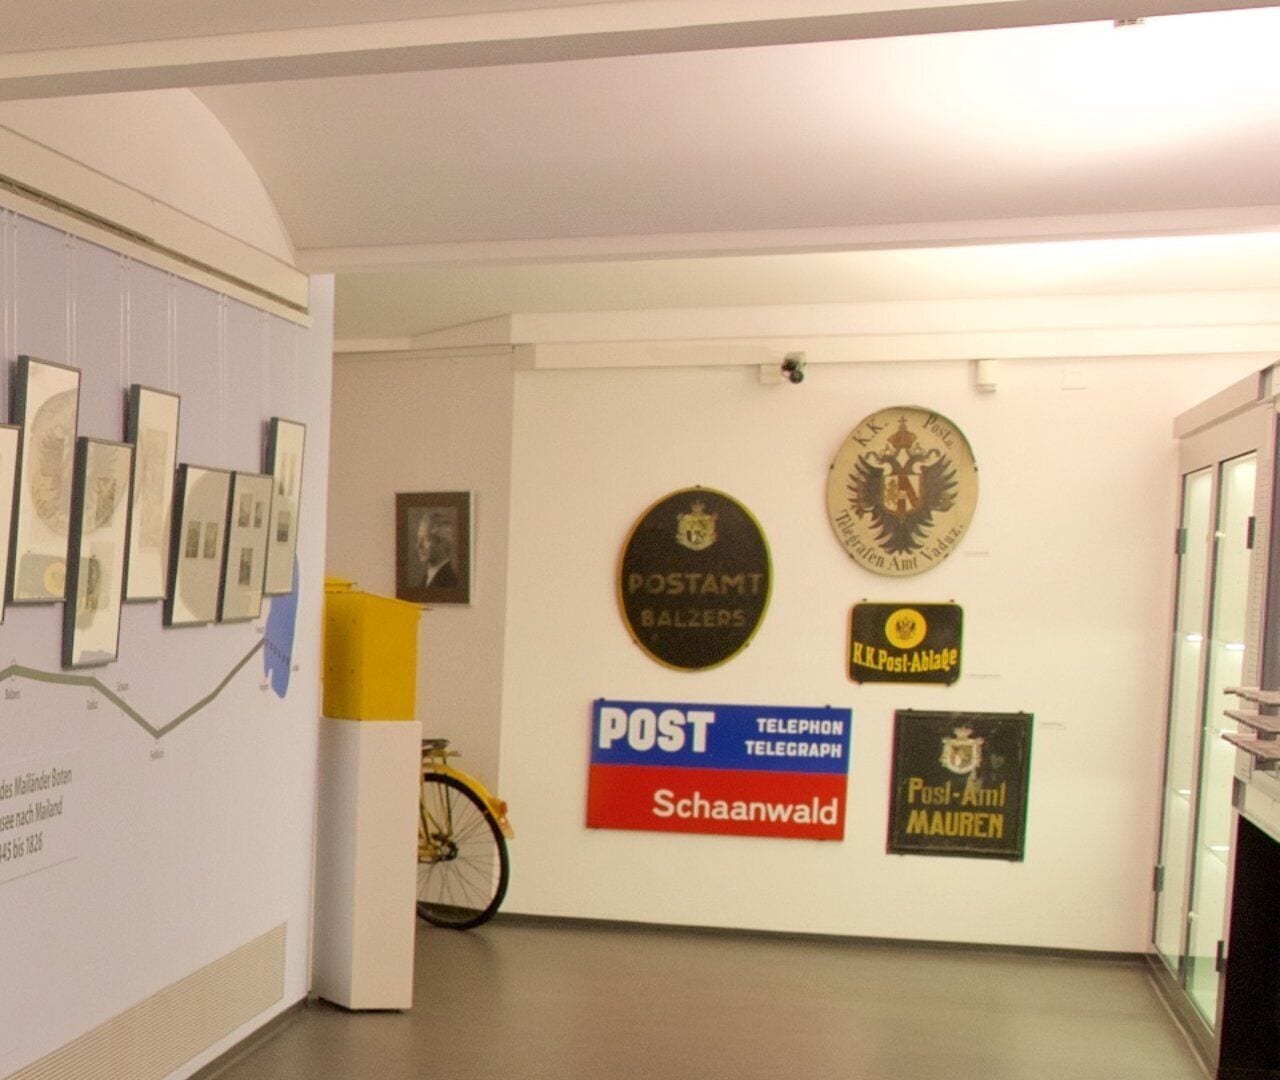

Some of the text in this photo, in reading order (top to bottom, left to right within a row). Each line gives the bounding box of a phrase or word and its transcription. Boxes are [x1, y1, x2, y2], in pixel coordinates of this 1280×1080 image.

[888, 556, 919, 572] Amt
[627, 572, 764, 596] POSTAMT
[641, 608, 747, 628] BALZERS
[598, 707, 716, 753] POST
[756, 717, 844, 736] TELEPHON
[744, 740, 843, 759] TELEGRAPH
[0, 779, 13, 800] des
[14, 770, 51, 796] Mailänder
[907, 776, 1007, 808] Post-Amt
[15, 806, 34, 828] nach
[35, 797, 64, 823] Mailand
[652, 788, 839, 826] Schaanwald
[906, 809, 1005, 839] MAUREN
[12, 838, 25, 859] bis
